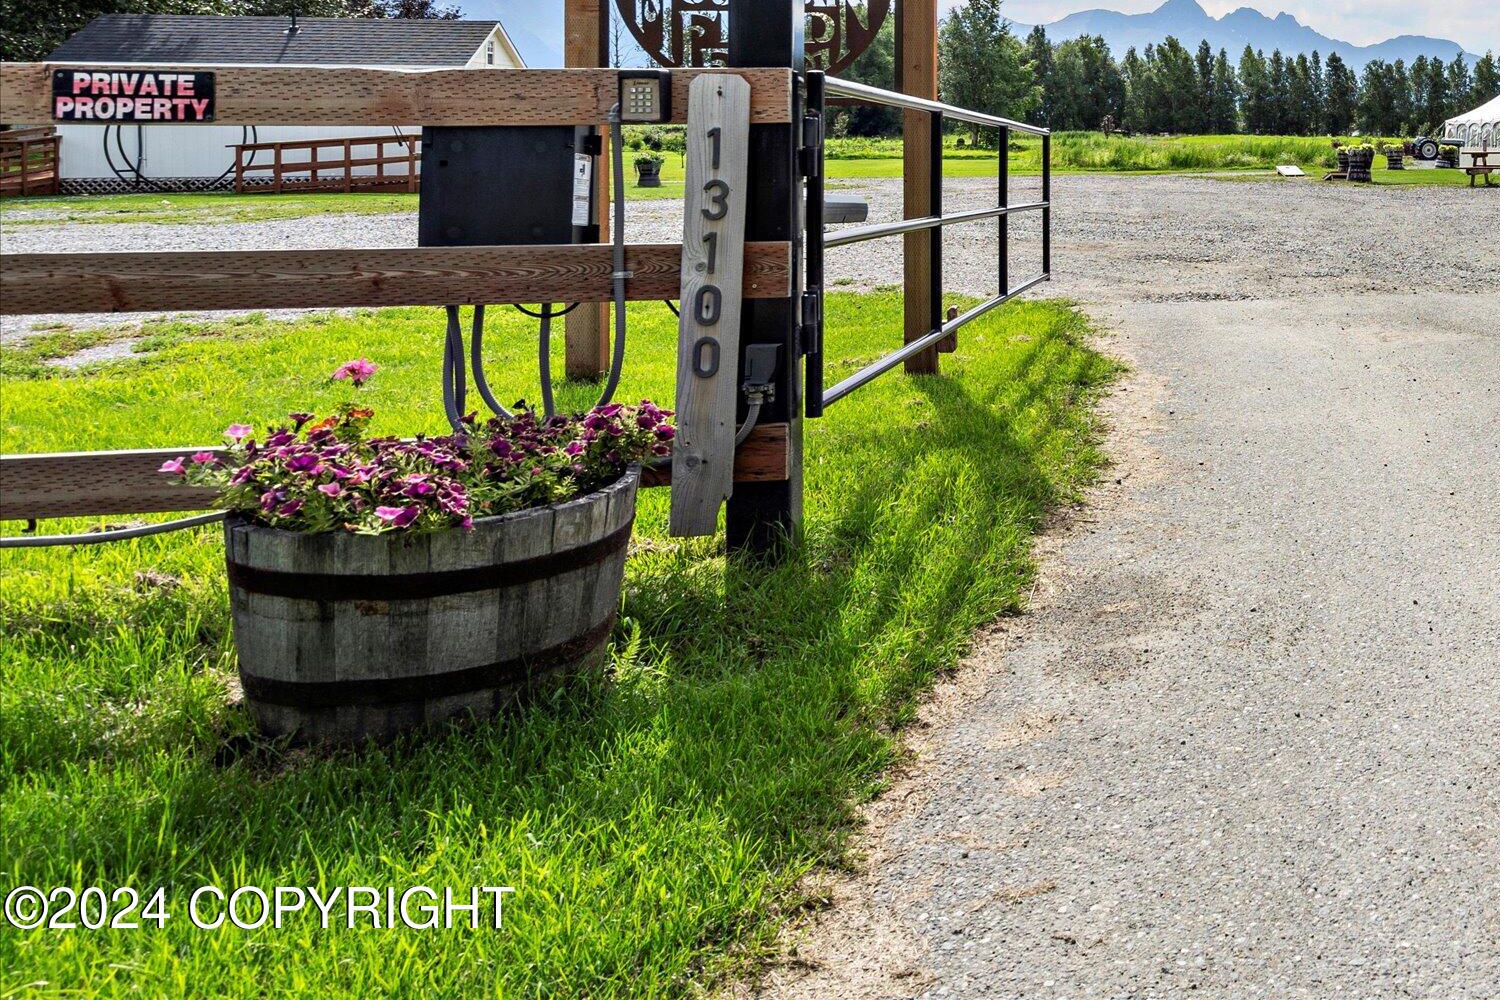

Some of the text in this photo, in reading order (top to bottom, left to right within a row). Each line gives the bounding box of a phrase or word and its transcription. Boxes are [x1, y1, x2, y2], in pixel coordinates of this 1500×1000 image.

[72, 72, 196, 96] PRIVATE
[55, 96, 210, 121] PROPERTY
[691, 126, 730, 379] 13100
